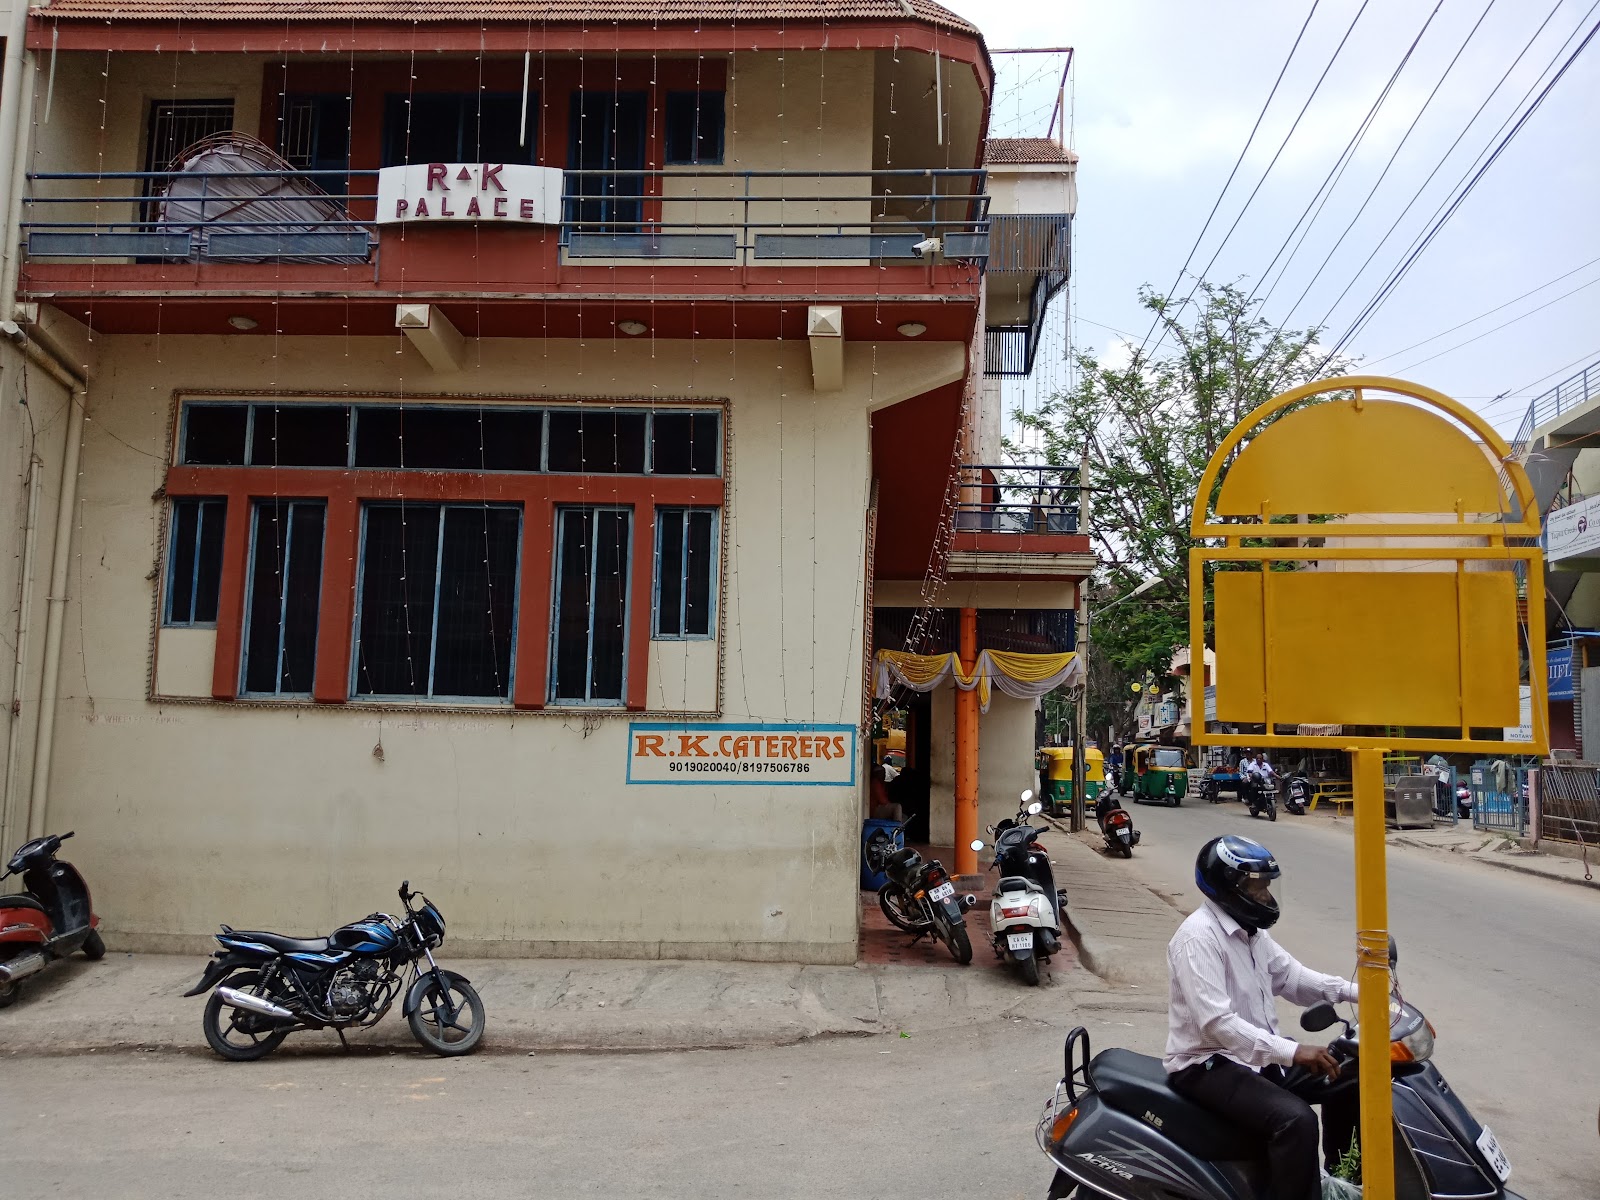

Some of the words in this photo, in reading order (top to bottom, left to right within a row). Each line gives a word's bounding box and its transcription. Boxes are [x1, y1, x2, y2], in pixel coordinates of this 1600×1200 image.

[427, 163, 450, 191] R
[481, 163, 507, 191] K
[396, 197, 534, 218] PALACE
[669, 762, 810, 774] 9019020040/8197506786
[1075, 1152, 1134, 1181] Activa
